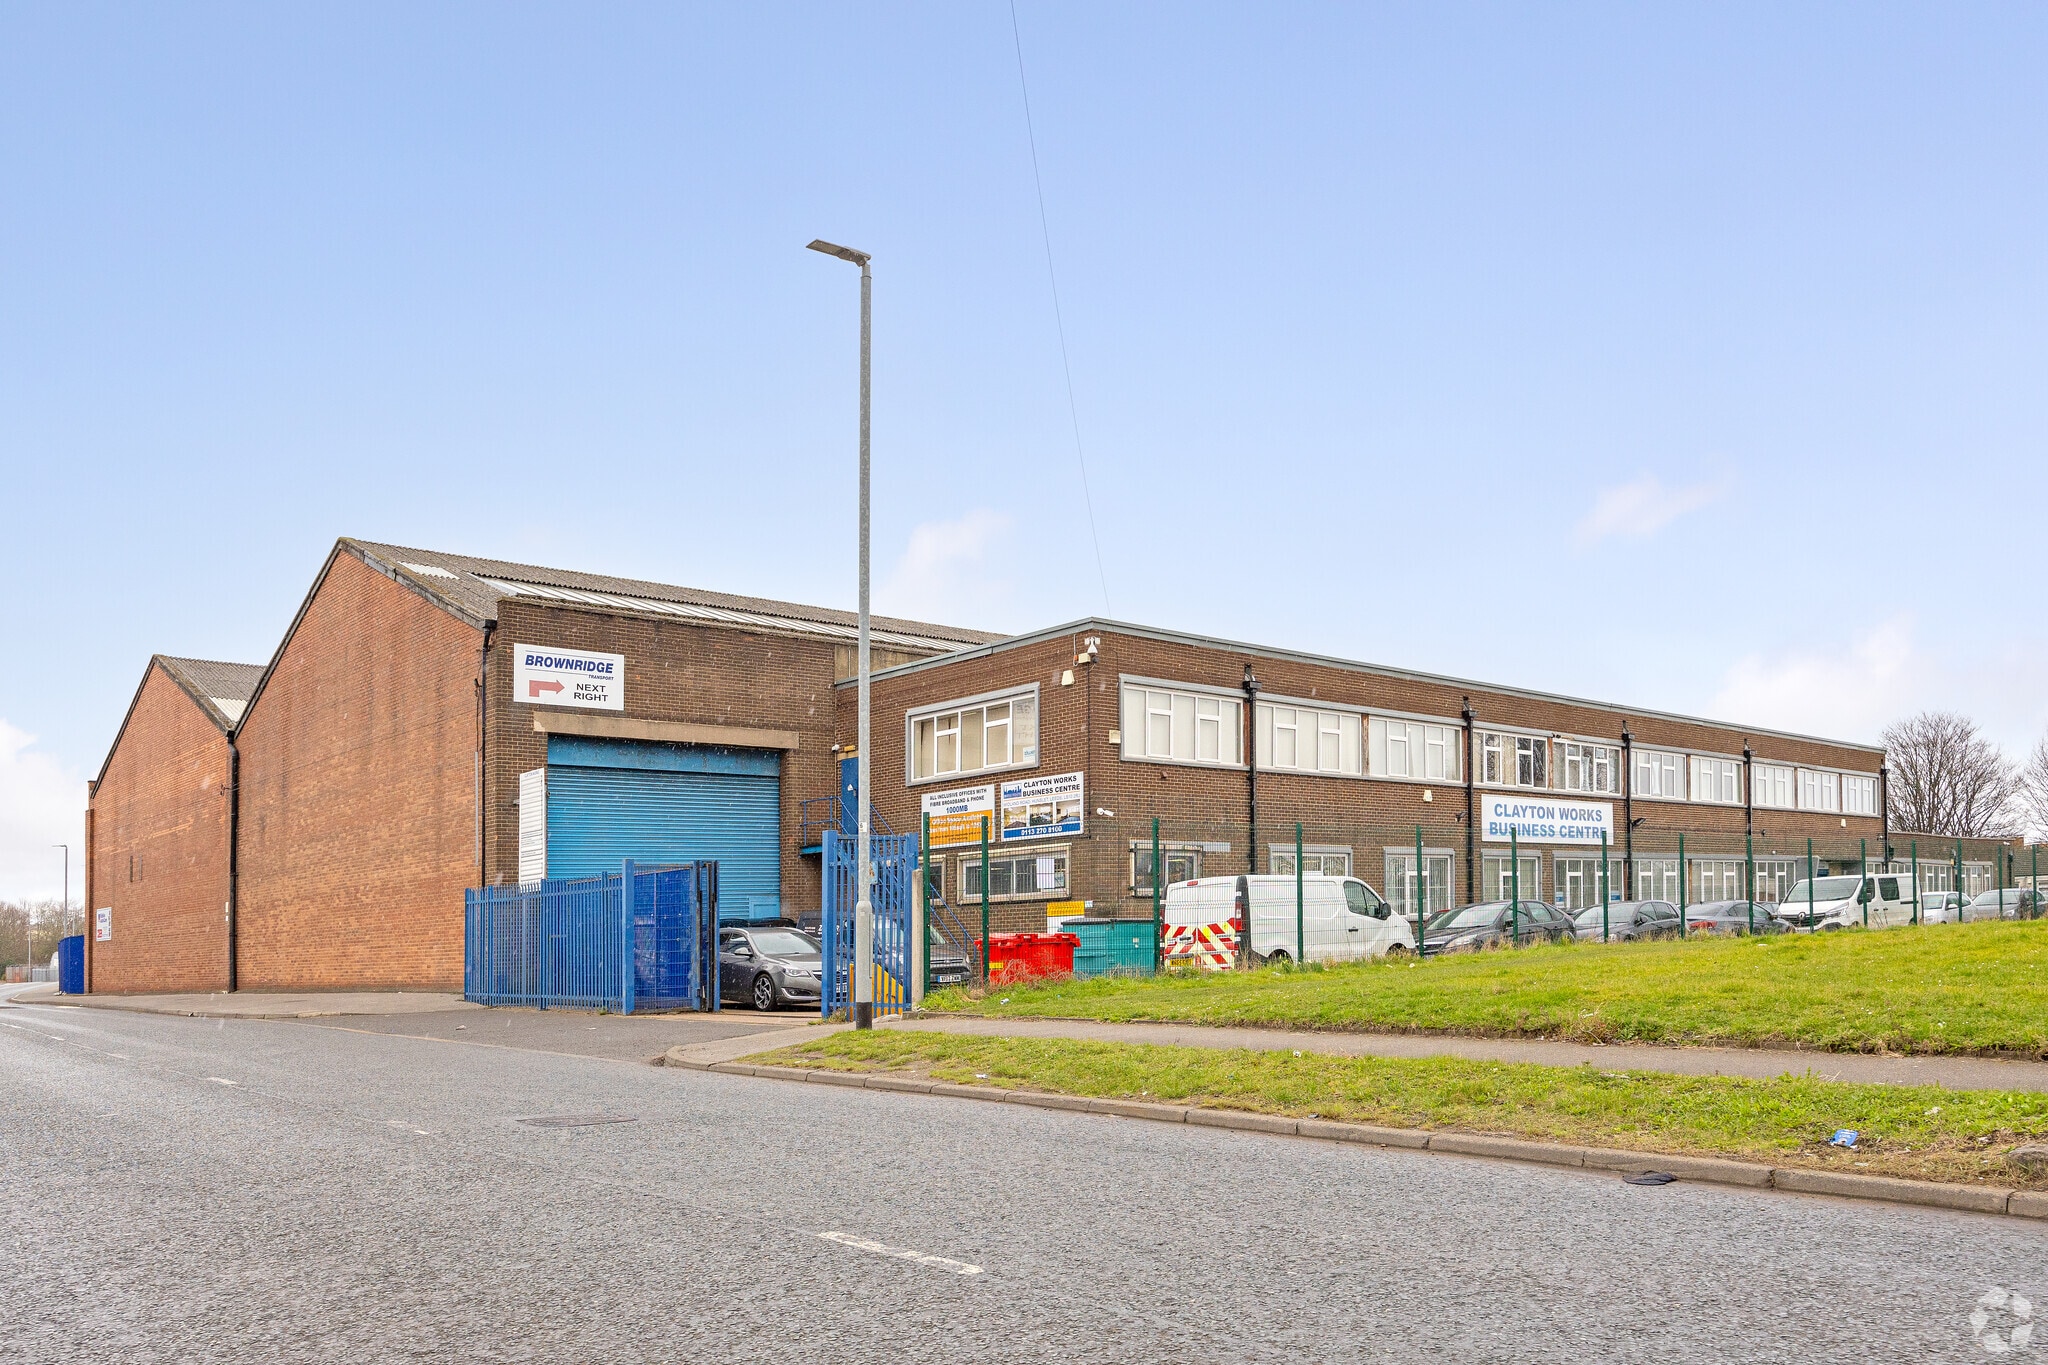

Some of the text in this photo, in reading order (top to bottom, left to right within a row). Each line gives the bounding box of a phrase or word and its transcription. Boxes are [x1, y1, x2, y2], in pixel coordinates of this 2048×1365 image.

[525, 654, 614, 673] BROWNRIDGE
[576, 683, 606, 692] NEXT
[573, 692, 608, 701] RIGHT
[1023, 775, 1077, 788] CLAYTON WORKS
[1022, 787, 1053, 797] BUSINESS
[1055, 783, 1080, 793] CENTRE
[946, 804, 969, 813] 1000MB
[1494, 803, 1603, 822] CLAYTON WORKS
